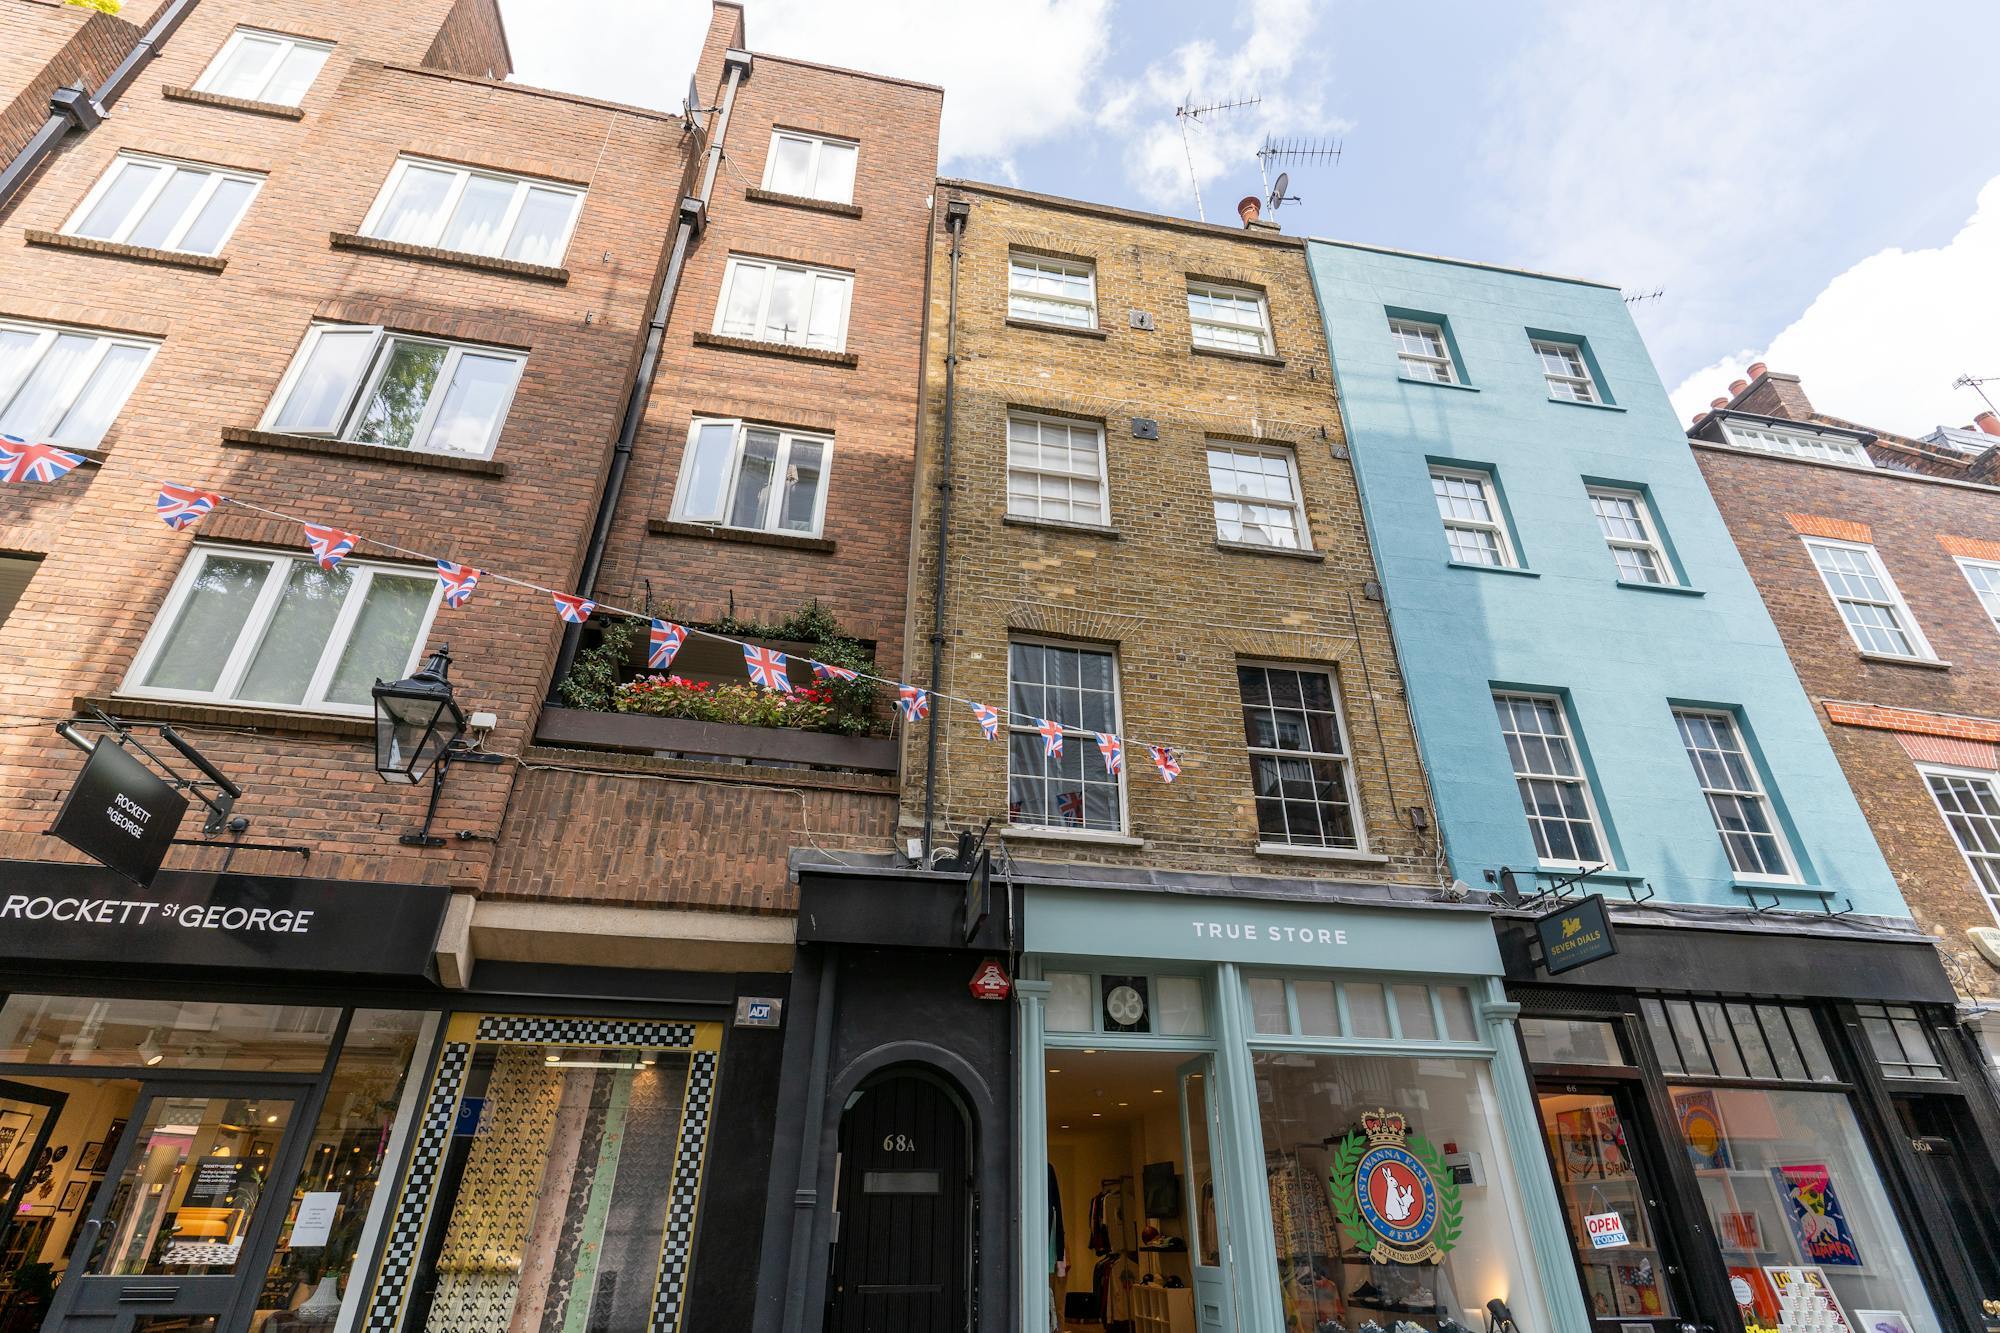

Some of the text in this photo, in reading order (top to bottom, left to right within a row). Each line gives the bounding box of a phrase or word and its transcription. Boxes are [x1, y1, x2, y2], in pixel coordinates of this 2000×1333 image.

[115, 793, 151, 823] ROCKETT
[110, 811, 144, 839] GEORGE
[0, 895, 314, 933] ROCKETT St GEORGE
[1193, 922, 1348, 945] TRUE STORE
[1551, 940, 1576, 956] SEVEN
[1576, 930, 1601, 946] DIALS
[750, 1005, 770, 1018] ADT
[883, 1134, 915, 1152] 68A
[1362, 1149, 1401, 1171] WANNA
[1359, 1176, 1371, 1211] JUST
[1427, 1193, 1435, 1224] YOU
[1388, 1229, 1420, 1241] #FR2
[1589, 1217, 1620, 1233] OPEN
[1594, 1233, 1625, 1245] TODAY
[1410, 1244, 1436, 1261] RABBITS
